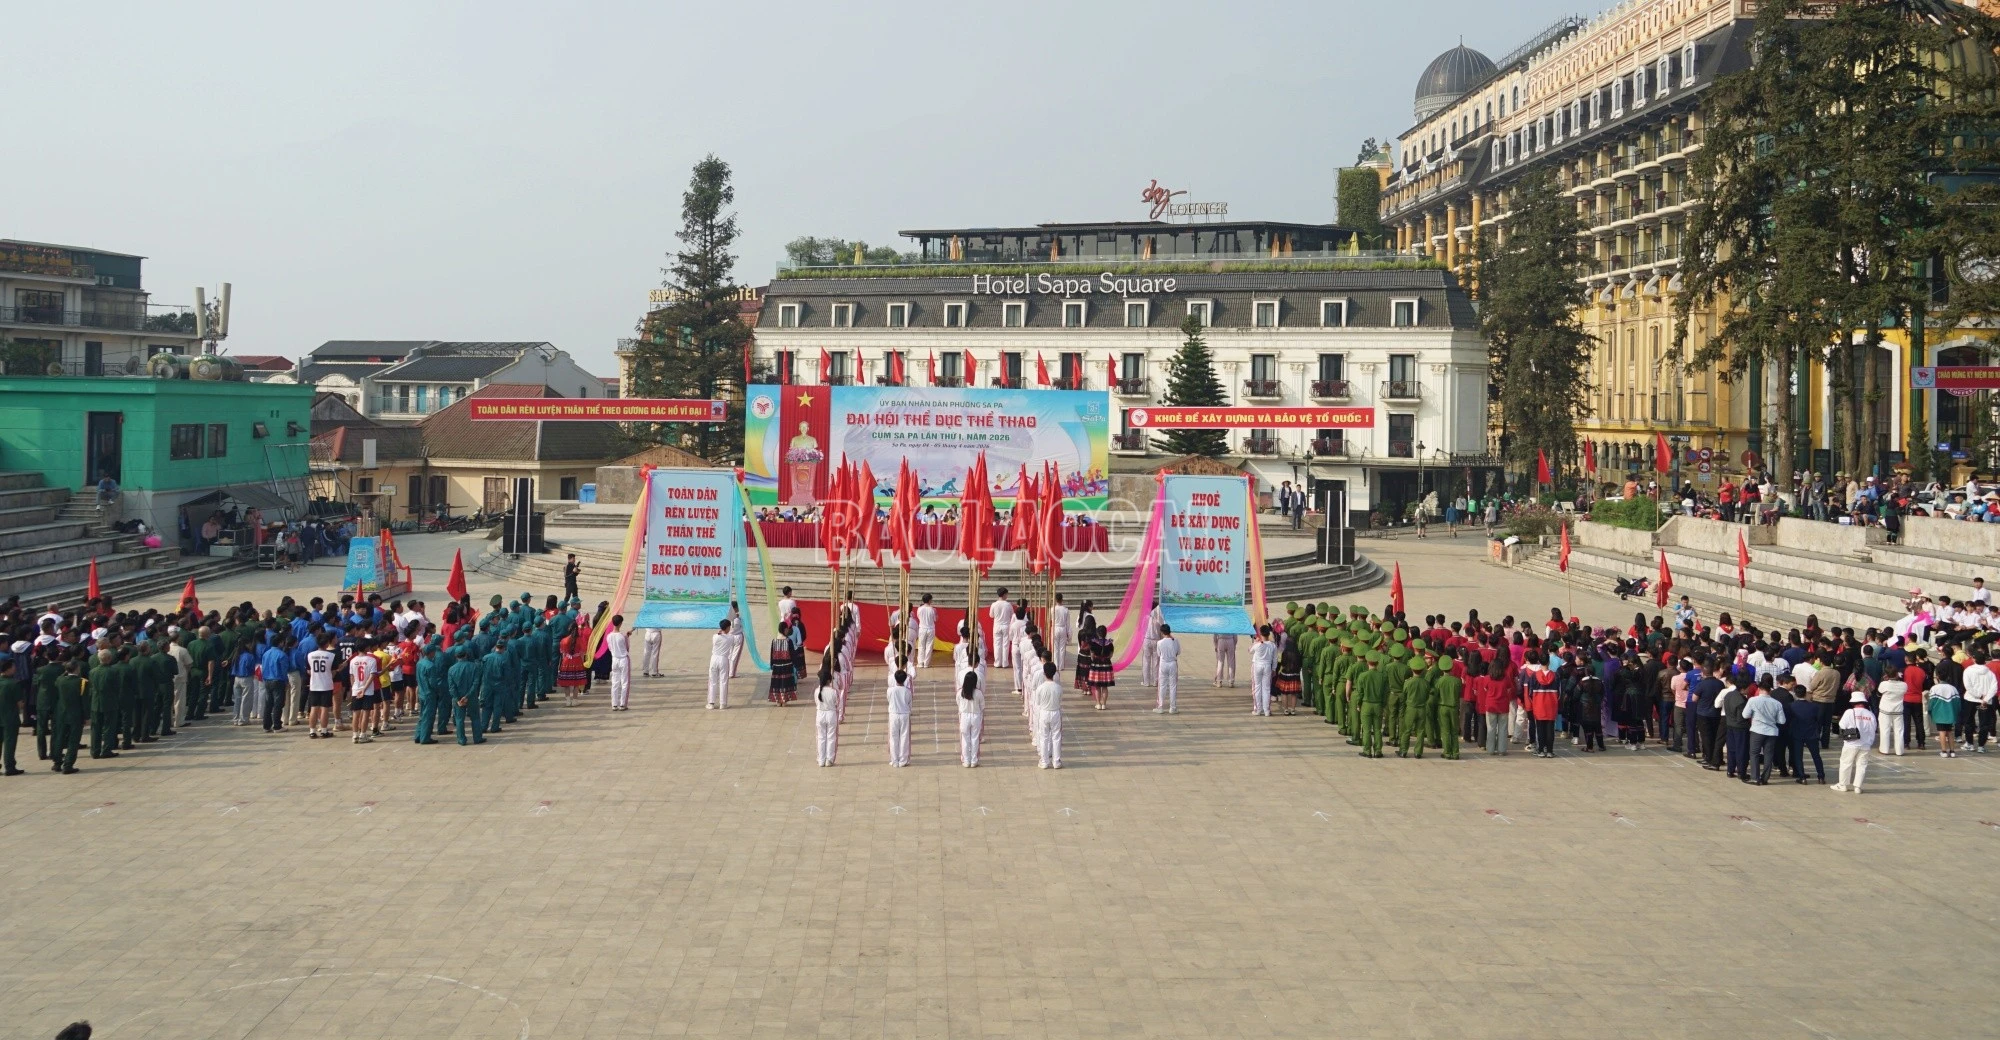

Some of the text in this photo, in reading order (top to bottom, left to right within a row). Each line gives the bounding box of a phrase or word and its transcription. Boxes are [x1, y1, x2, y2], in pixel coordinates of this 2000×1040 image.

[1168, 203, 1228, 216] LOUNGE
[972, 272, 1177, 299] Hotel Sapa Square
[477, 405, 498, 415] TOÀN
[500, 405, 517, 415] DÂN
[519, 405, 535, 415] RÈN
[537, 405, 561, 416] LUYỆN
[563, 405, 584, 415] THÂN
[586, 404, 601, 415] THỂ
[602, 406, 621, 415] THEO
[623, 406, 649, 415] GƯƠNG
[651, 405, 666, 415] BÁC
[668, 404, 679, 415] HỒ
[680, 406, 688, 415] VĨ
[689, 407, 701, 417] ĐẠI
[880, 399, 890, 407] ỦY
[932, 400, 948, 408] DÂN
[846, 410, 1037, 429] ĐẠI HỘI THỂ DỤC THỂ THAO
[1154, 412, 1182, 423] KHOẺ
[1185, 412, 1200, 423] ĐỂ
[1201, 413, 1222, 423] XÂY
[1225, 413, 1255, 424] DỰNG
[1257, 413, 1272, 423] VÀ
[1274, 412, 1297, 423] BẢO
[1299, 413, 1313, 424] VỆ
[1316, 412, 1330, 423] TỔ
[1332, 412, 1362, 423] QUỐC
[872, 431, 892, 441] CỤM
[907, 432, 918, 440] PA
[921, 431, 938, 440] LẦN
[940, 432, 957, 440] THỨ
[966, 432, 987, 441] NĂM
[667, 486, 718, 500] TOÀN DÂN
[1192, 490, 1220, 506] KHOẺ
[664, 505, 719, 522] RÈN LUYỆN
[1171, 509, 1240, 532] ĐỂ XÂY DỰNG
[667, 523, 716, 538] THÂN THỂ
[658, 545, 722, 558] THEO GƯƠNG
[1178, 534, 1231, 554] VÀ BẢO VỆ
[651, 560, 727, 580] BÁC HỒ VĨ ĐẠI !
[1179, 554, 1229, 576] TỔ QUỐC !
[341, 647, 353, 660] 19
[313, 660, 326, 673] 06
[357, 665, 365, 682] 6
